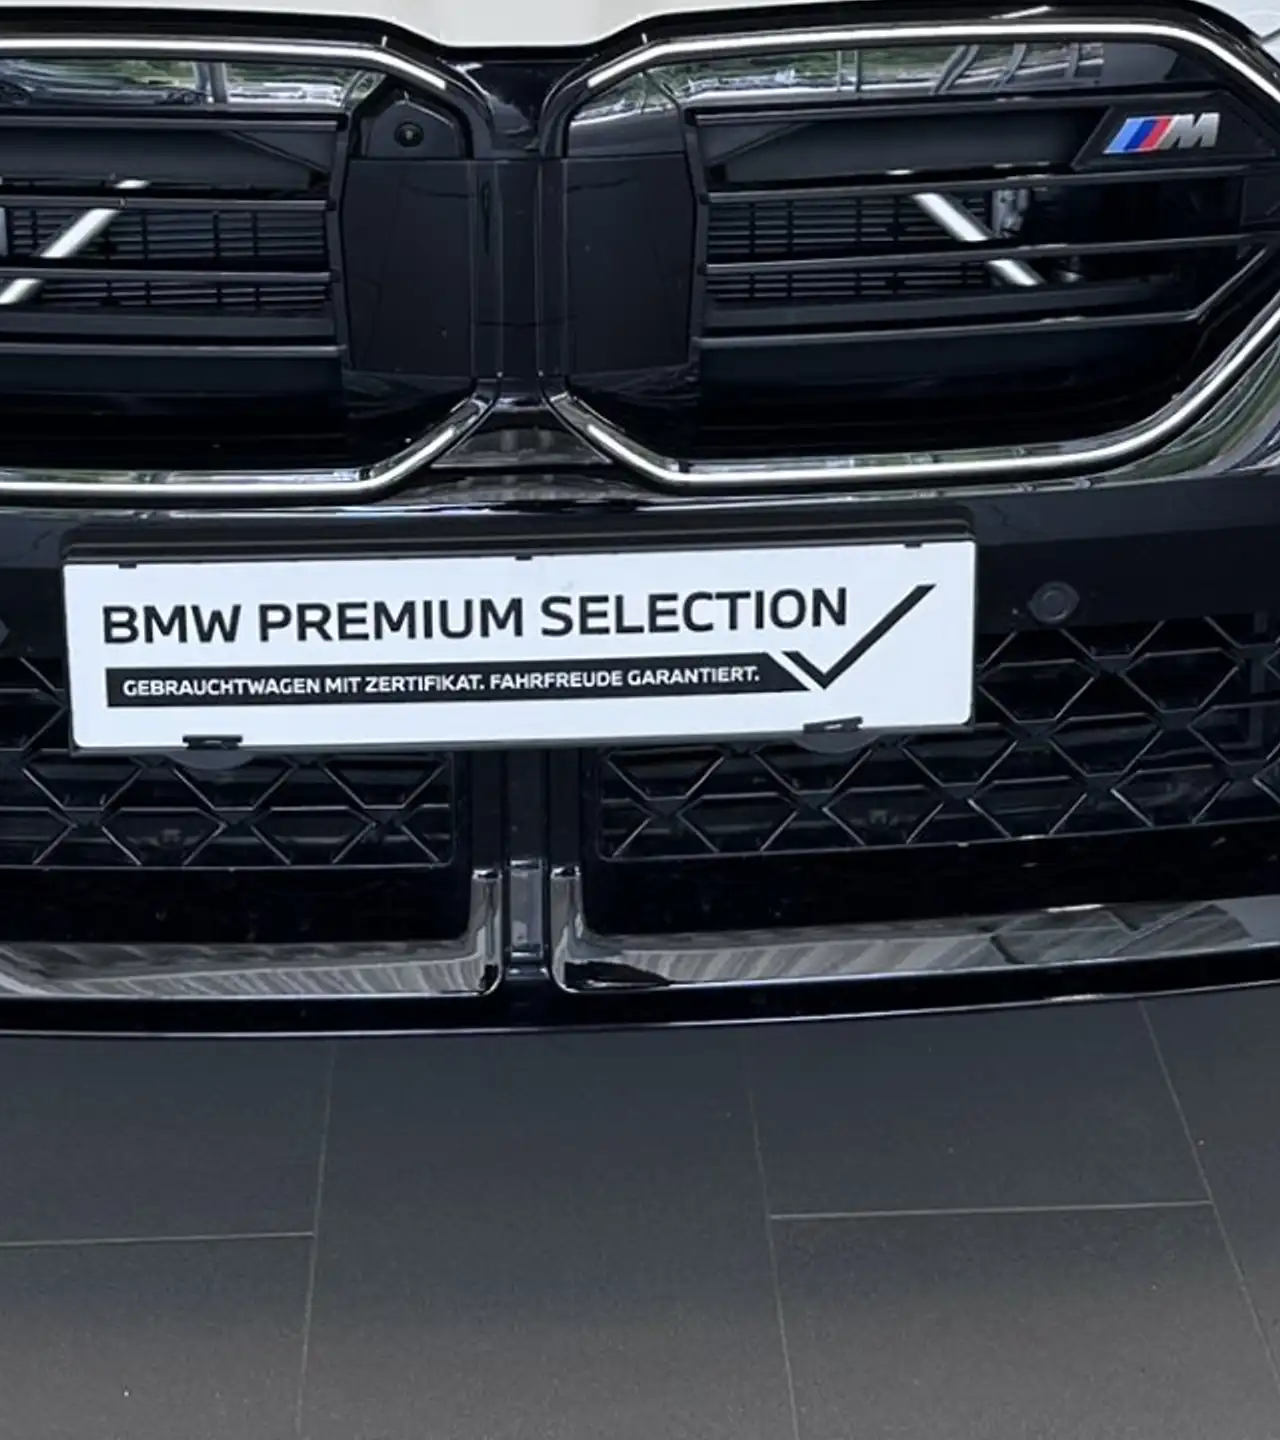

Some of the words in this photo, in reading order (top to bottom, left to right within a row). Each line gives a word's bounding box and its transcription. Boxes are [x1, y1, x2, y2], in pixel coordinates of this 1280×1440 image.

[102, 604, 242, 645] BMW
[259, 597, 524, 643] PREMIUM
[541, 586, 847, 637] SELECTION
[123, 677, 320, 696] GEBRAUCHTWAGEN
[325, 675, 361, 694] MIT
[365, 673, 486, 693] ZERTIFIKAT.
[490, 670, 623, 689] FAHRFREUDE
[627, 666, 760, 686] GARANTIERT.
